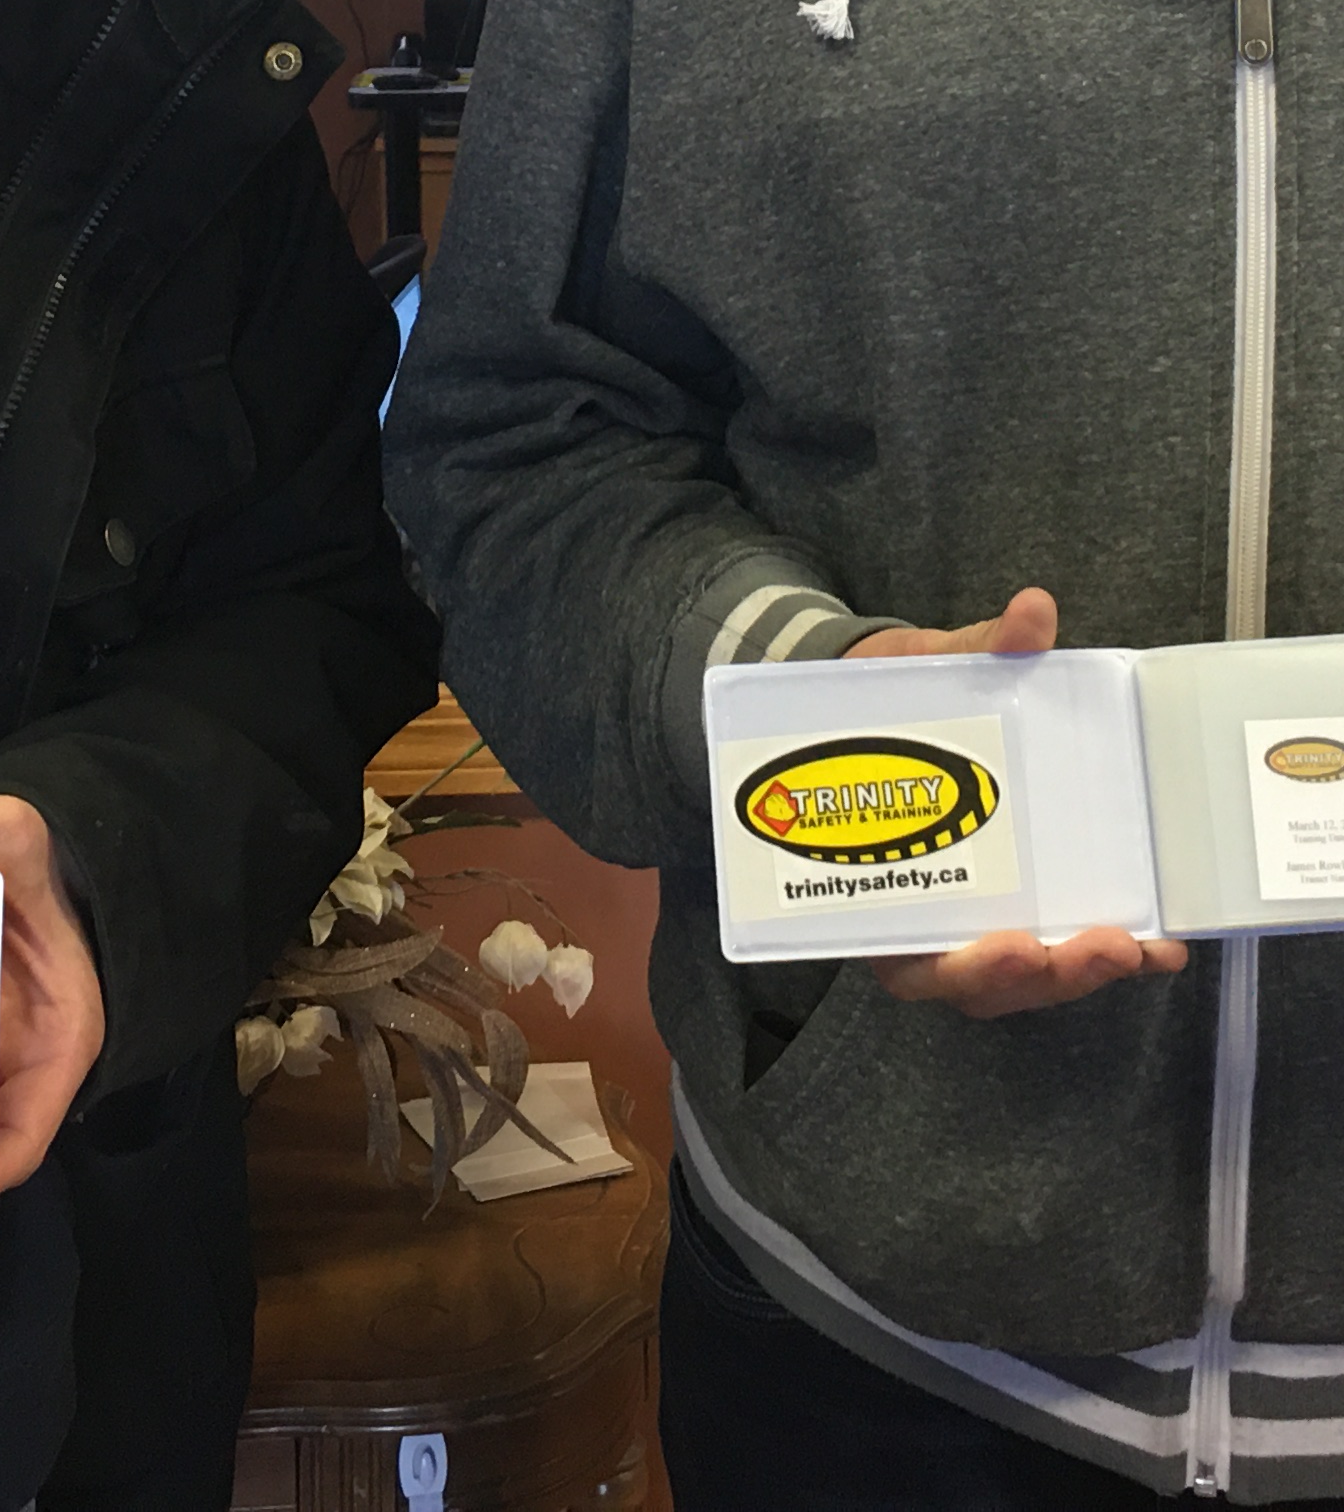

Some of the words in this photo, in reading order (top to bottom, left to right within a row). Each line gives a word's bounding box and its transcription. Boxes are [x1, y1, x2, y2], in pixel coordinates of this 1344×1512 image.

[1285, 752, 1344, 765] TRINITY
[789, 775, 943, 817] TRINITY
[799, 812, 853, 829] SAFETY
[859, 811, 869, 824] &
[874, 804, 943, 822] TRAINING
[1288, 819, 1320, 832] March
[784, 867, 969, 900] trinitysafety.ca
